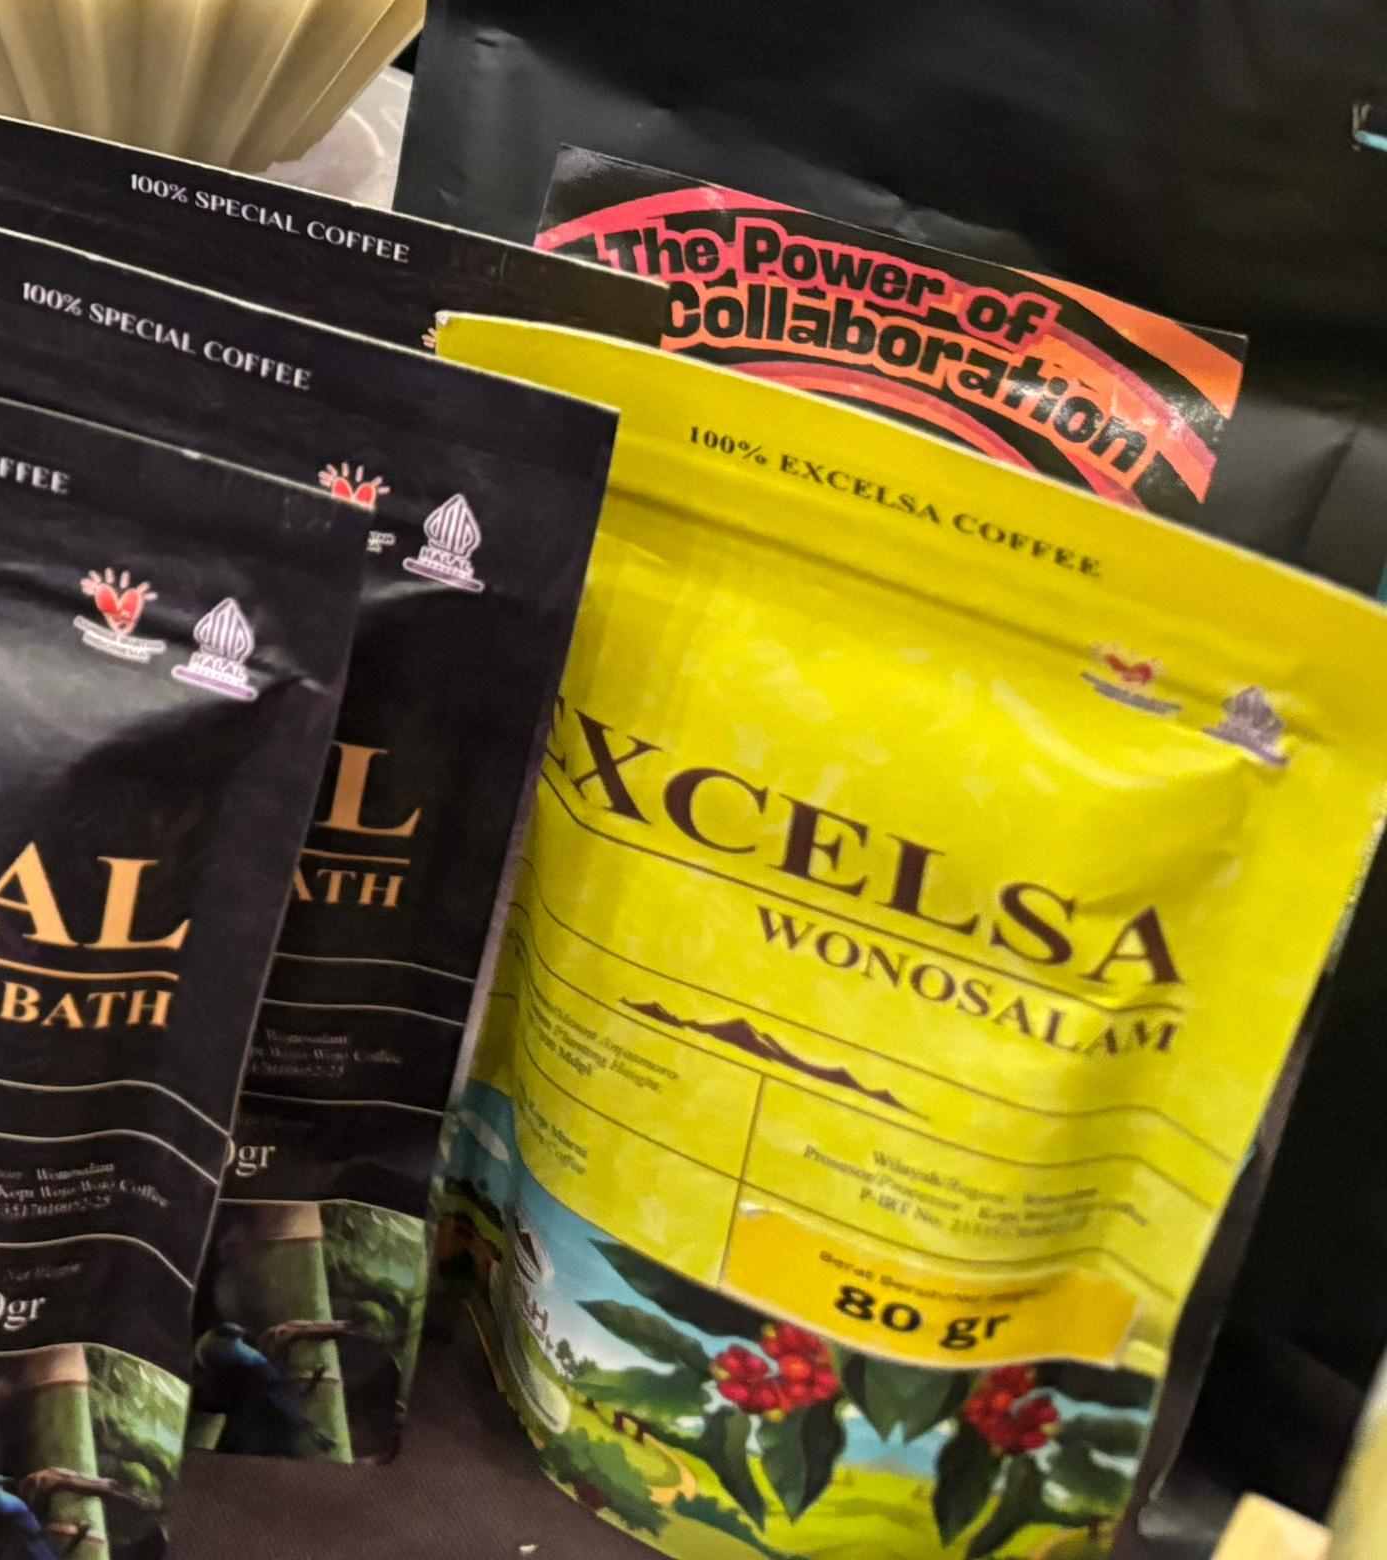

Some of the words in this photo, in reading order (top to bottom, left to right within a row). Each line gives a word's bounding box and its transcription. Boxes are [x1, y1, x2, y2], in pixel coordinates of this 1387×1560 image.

[130, 171, 189, 206] 100%
[193, 188, 302, 236] SPECIAL
[306, 218, 411, 265] COFFEE
[21, 280, 83, 318] 100%
[88, 301, 197, 355] SPECIAL
[202, 337, 314, 392] COFFEE
[600, 223, 720, 280] The
[738, 219, 947, 308] Power
[960, 290, 1049, 342] of
[663, 278, 1152, 475] Collaboration
[686, 423, 769, 466] 100%
[778, 448, 942, 526] EXCELSA
[951, 507, 1105, 578] COFFEE
[755, 904, 1184, 1056] WONOSALAM
[834, 1284, 922, 1333] 80
[938, 1311, 1012, 1352] gr
